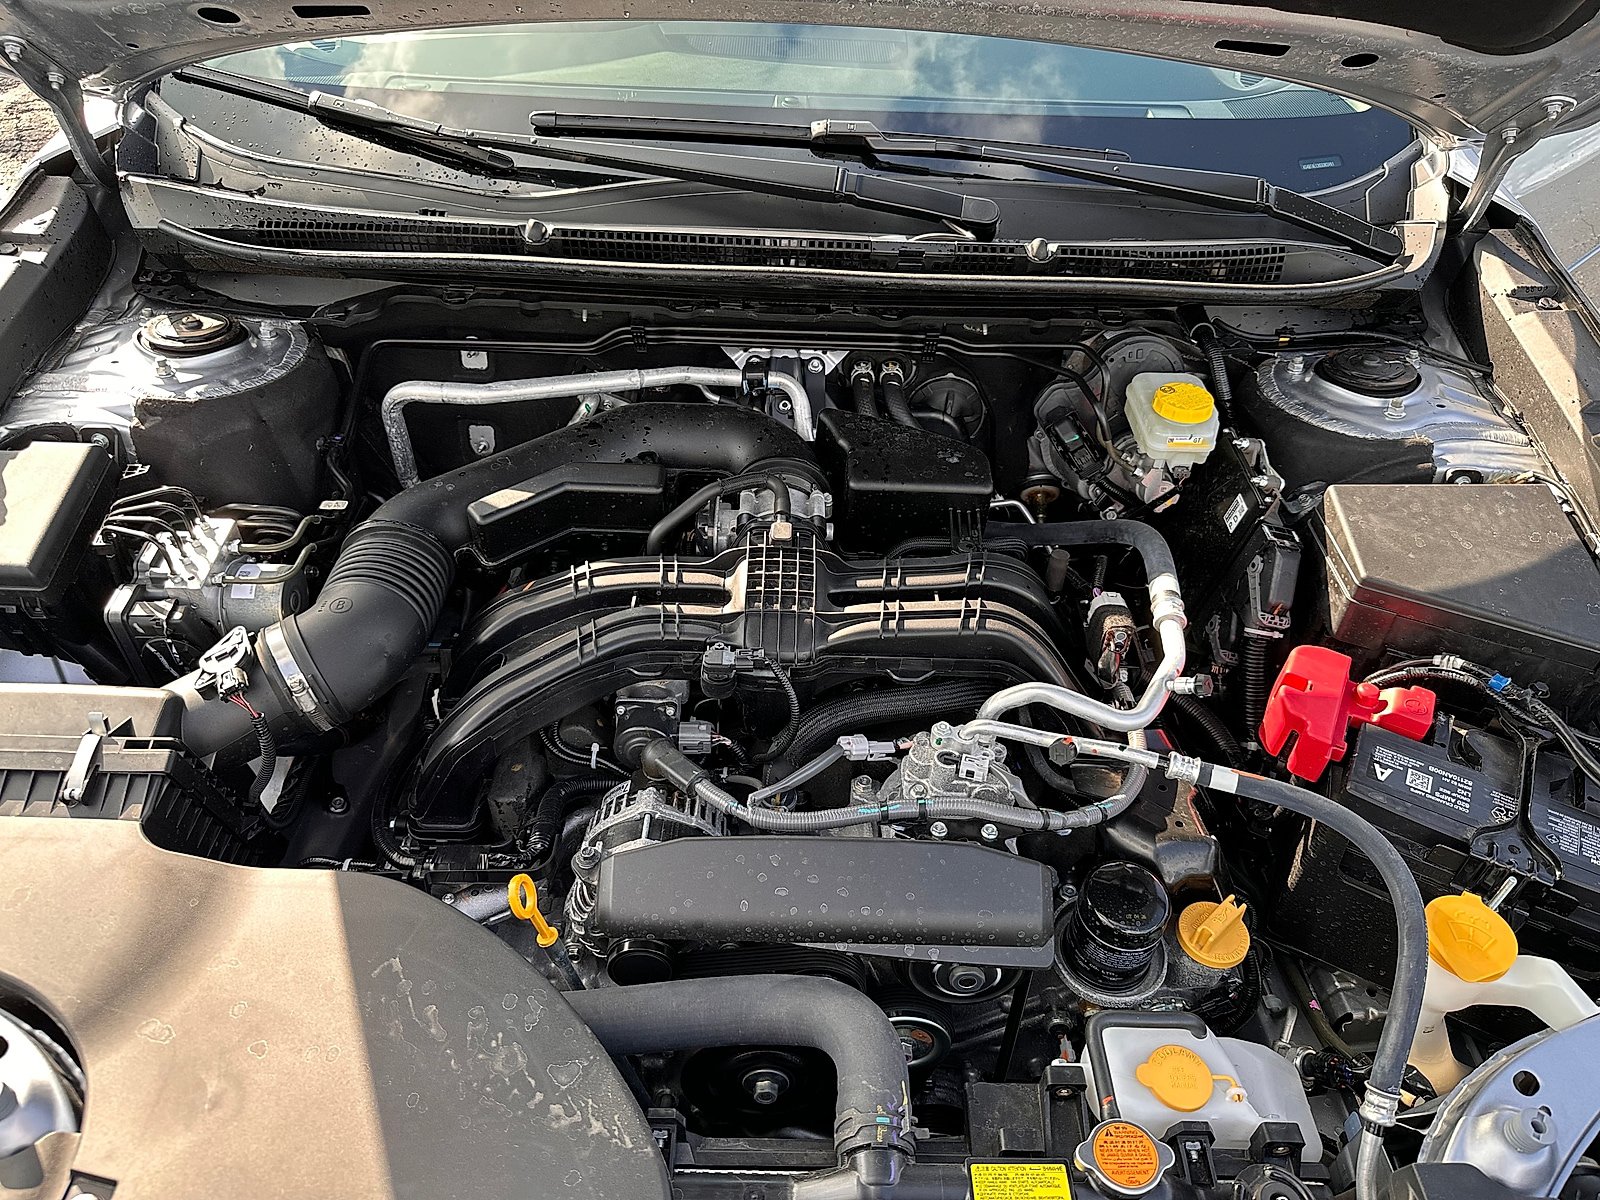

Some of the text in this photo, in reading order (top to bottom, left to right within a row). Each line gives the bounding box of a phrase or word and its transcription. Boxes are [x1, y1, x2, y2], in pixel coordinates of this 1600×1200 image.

[1374, 763, 1394, 781] A
[1435, 792, 1456, 803] AMPS
[1454, 805, 1470, 814] COLD
[1152, 1048, 1201, 1067] COOLANT
